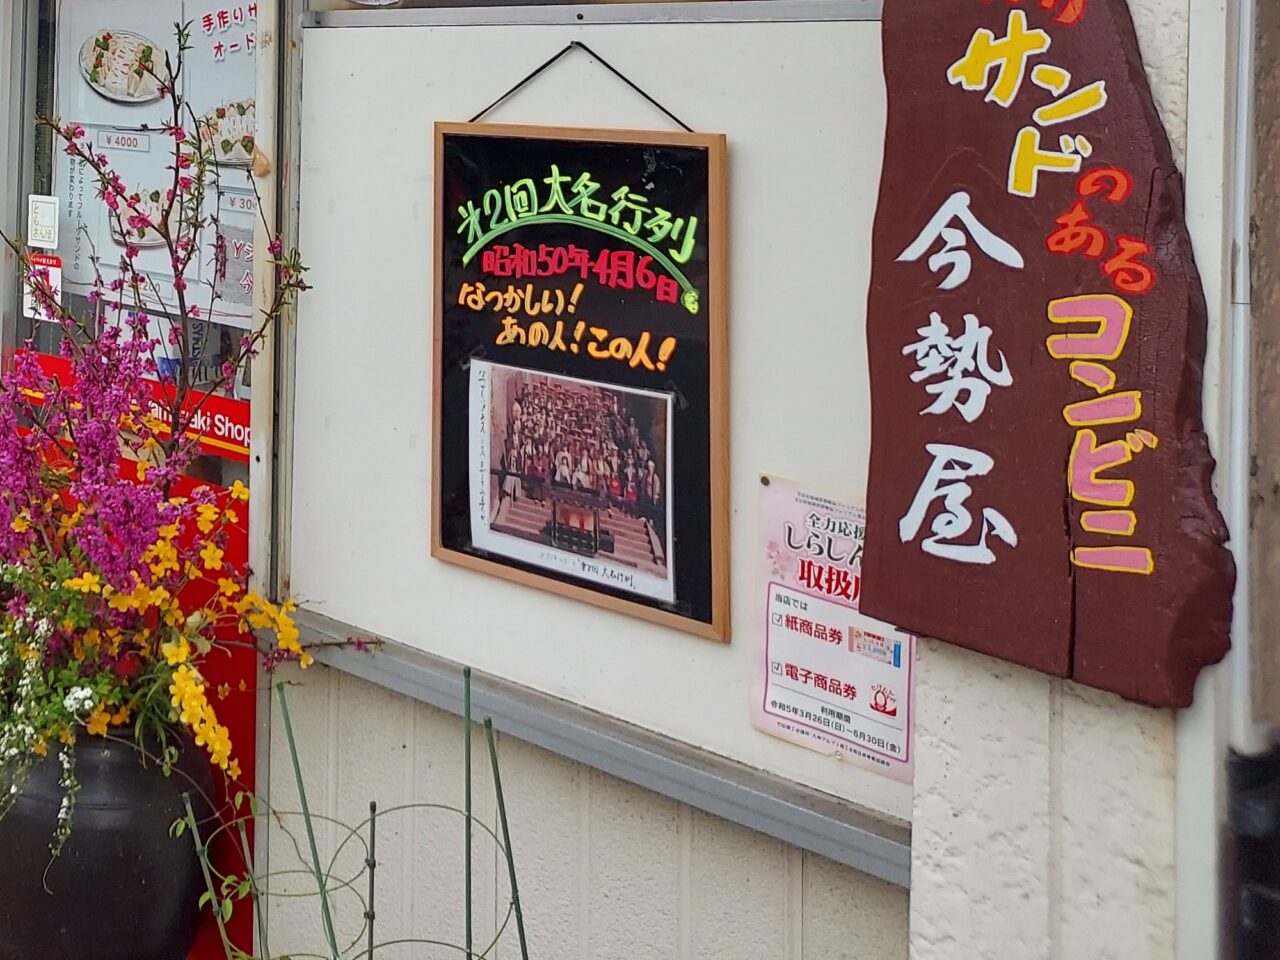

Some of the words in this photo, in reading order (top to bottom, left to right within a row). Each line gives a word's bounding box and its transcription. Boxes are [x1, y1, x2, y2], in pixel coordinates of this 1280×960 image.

[482, 242, 678, 304] 昭和50年4月6日
[894, 190, 1025, 564] 今勢屋
[774, 592, 809, 611] 当店では
[784, 613, 843, 646] 紙商品券
[784, 662, 858, 701] 電子商品券
[821, 705, 851, 724] 利用期間
